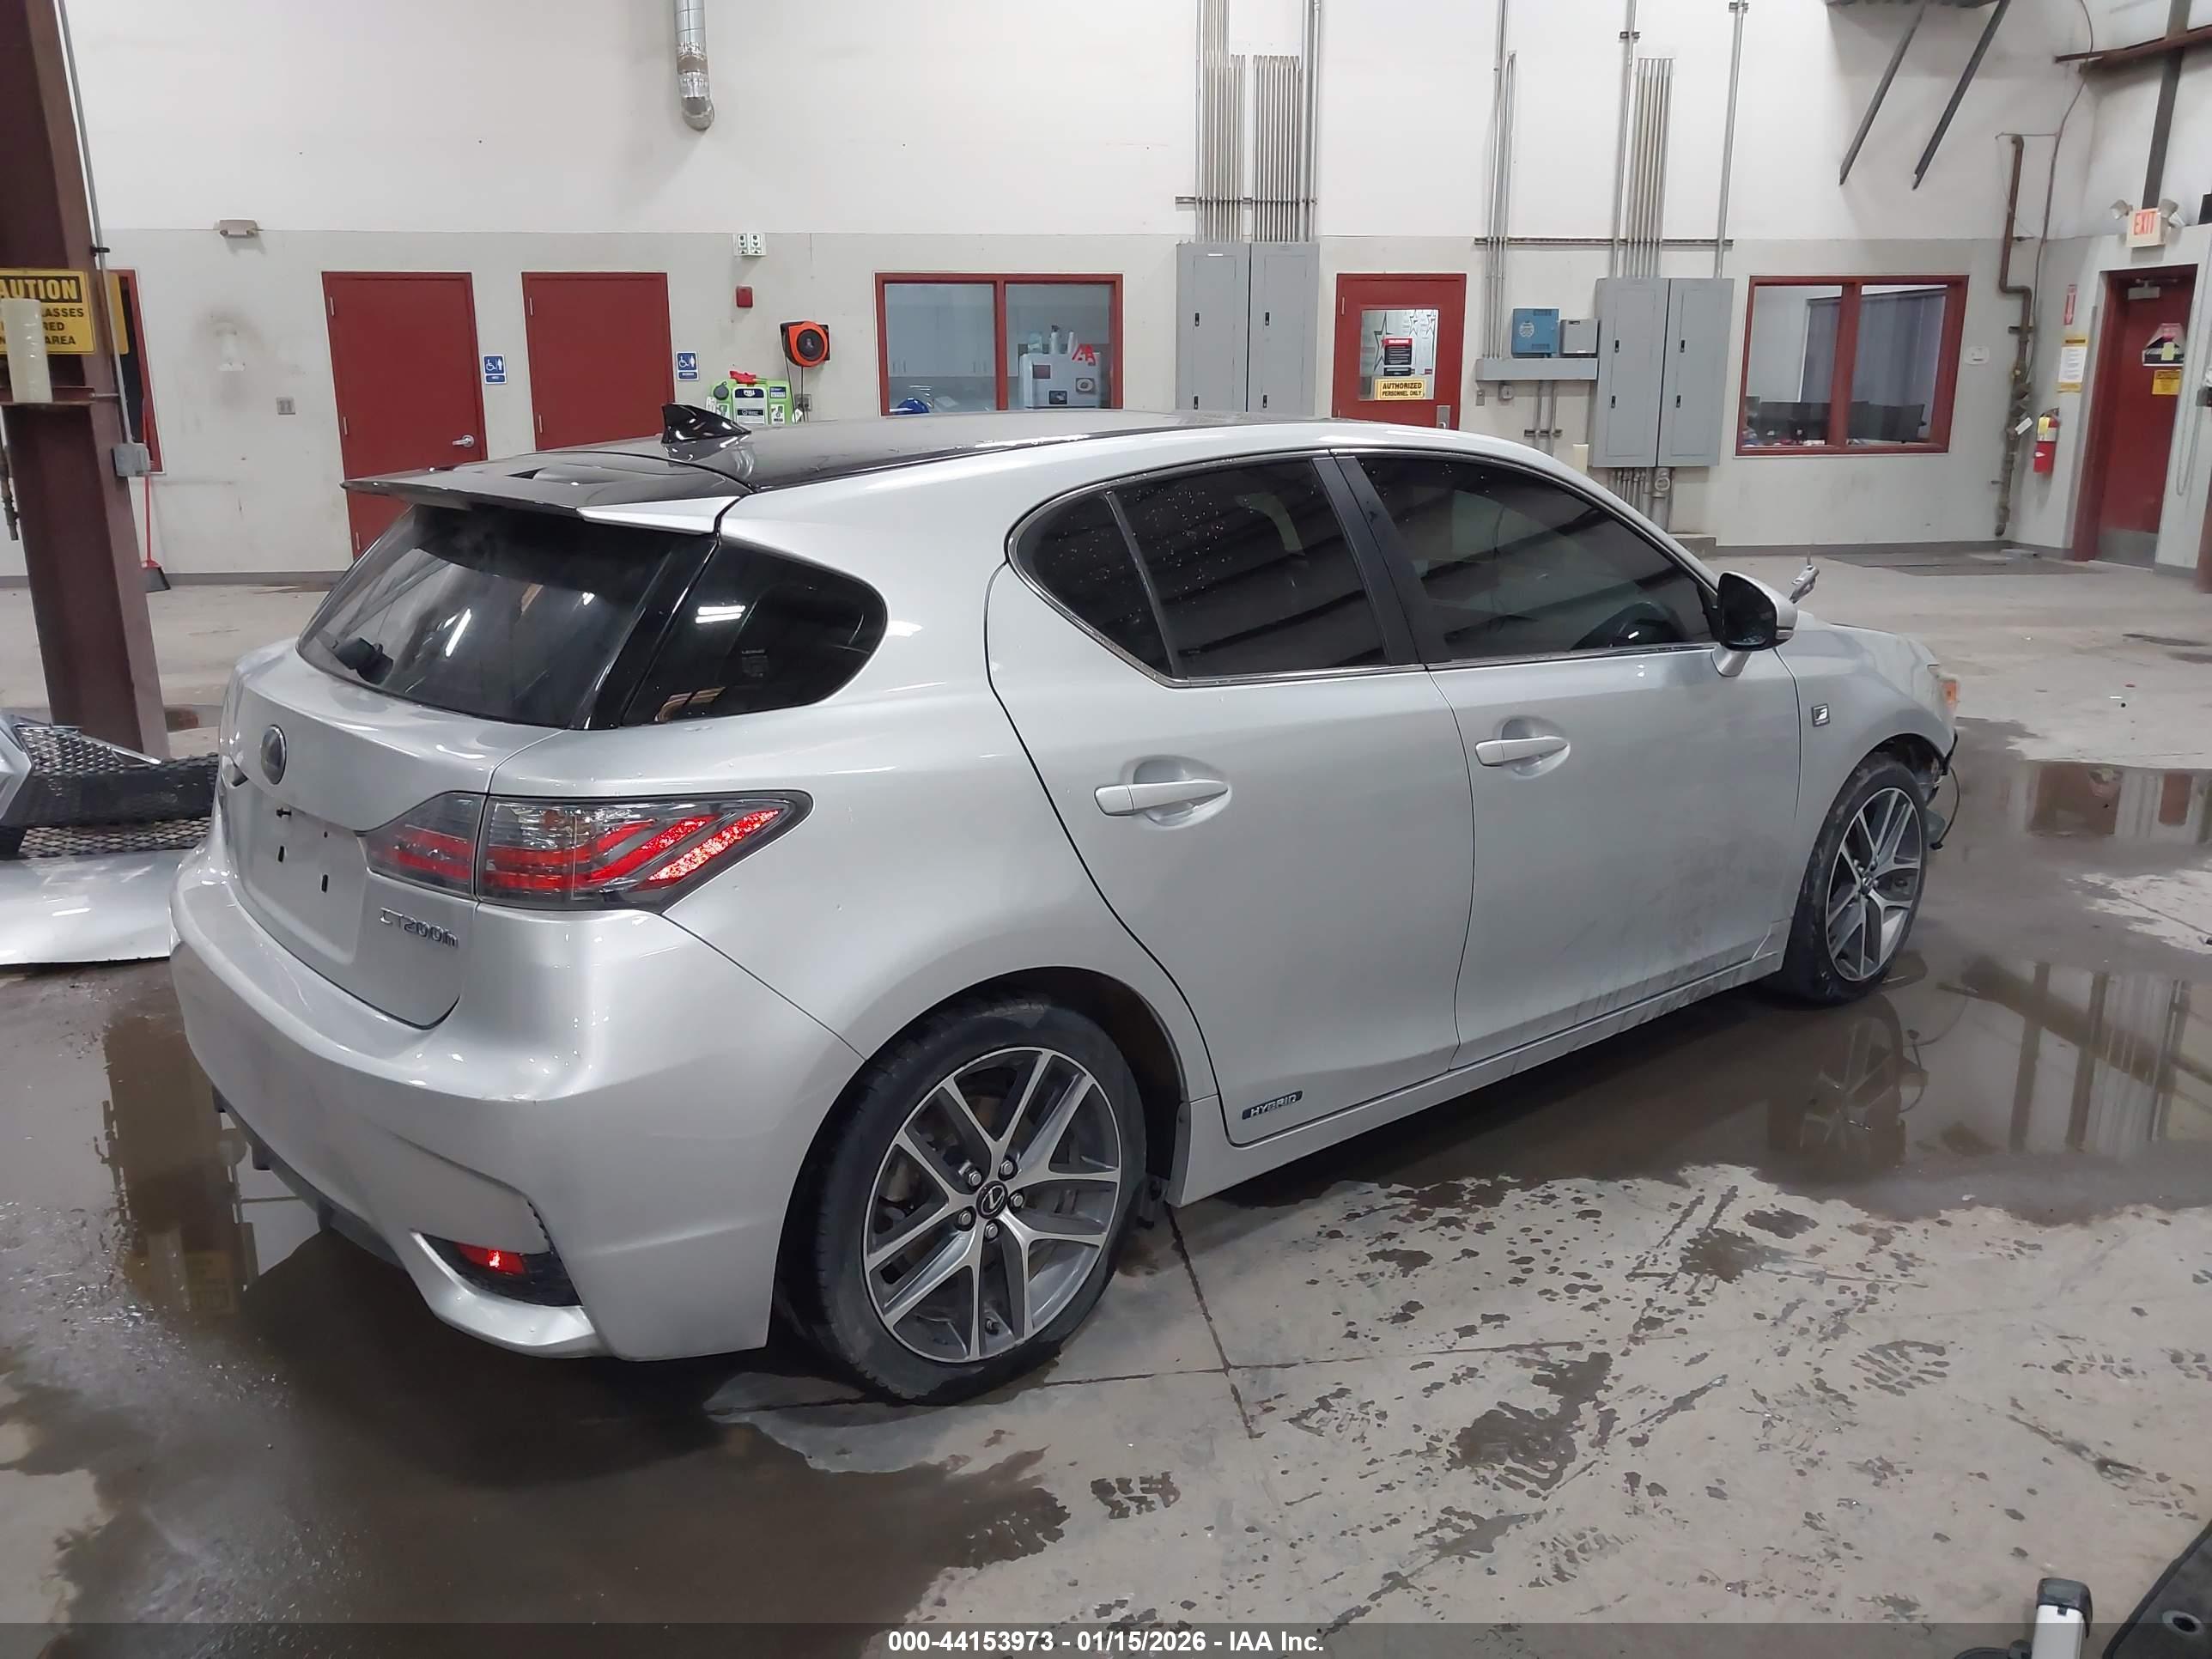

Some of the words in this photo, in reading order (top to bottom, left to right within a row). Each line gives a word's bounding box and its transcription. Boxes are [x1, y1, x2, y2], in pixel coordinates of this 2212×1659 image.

[2134, 211, 2156, 235] EXIT
[0, 279, 78, 300] AUTION
[42, 307, 84, 318] ASSES
[1250, 1093, 1297, 1117] HYBRID
